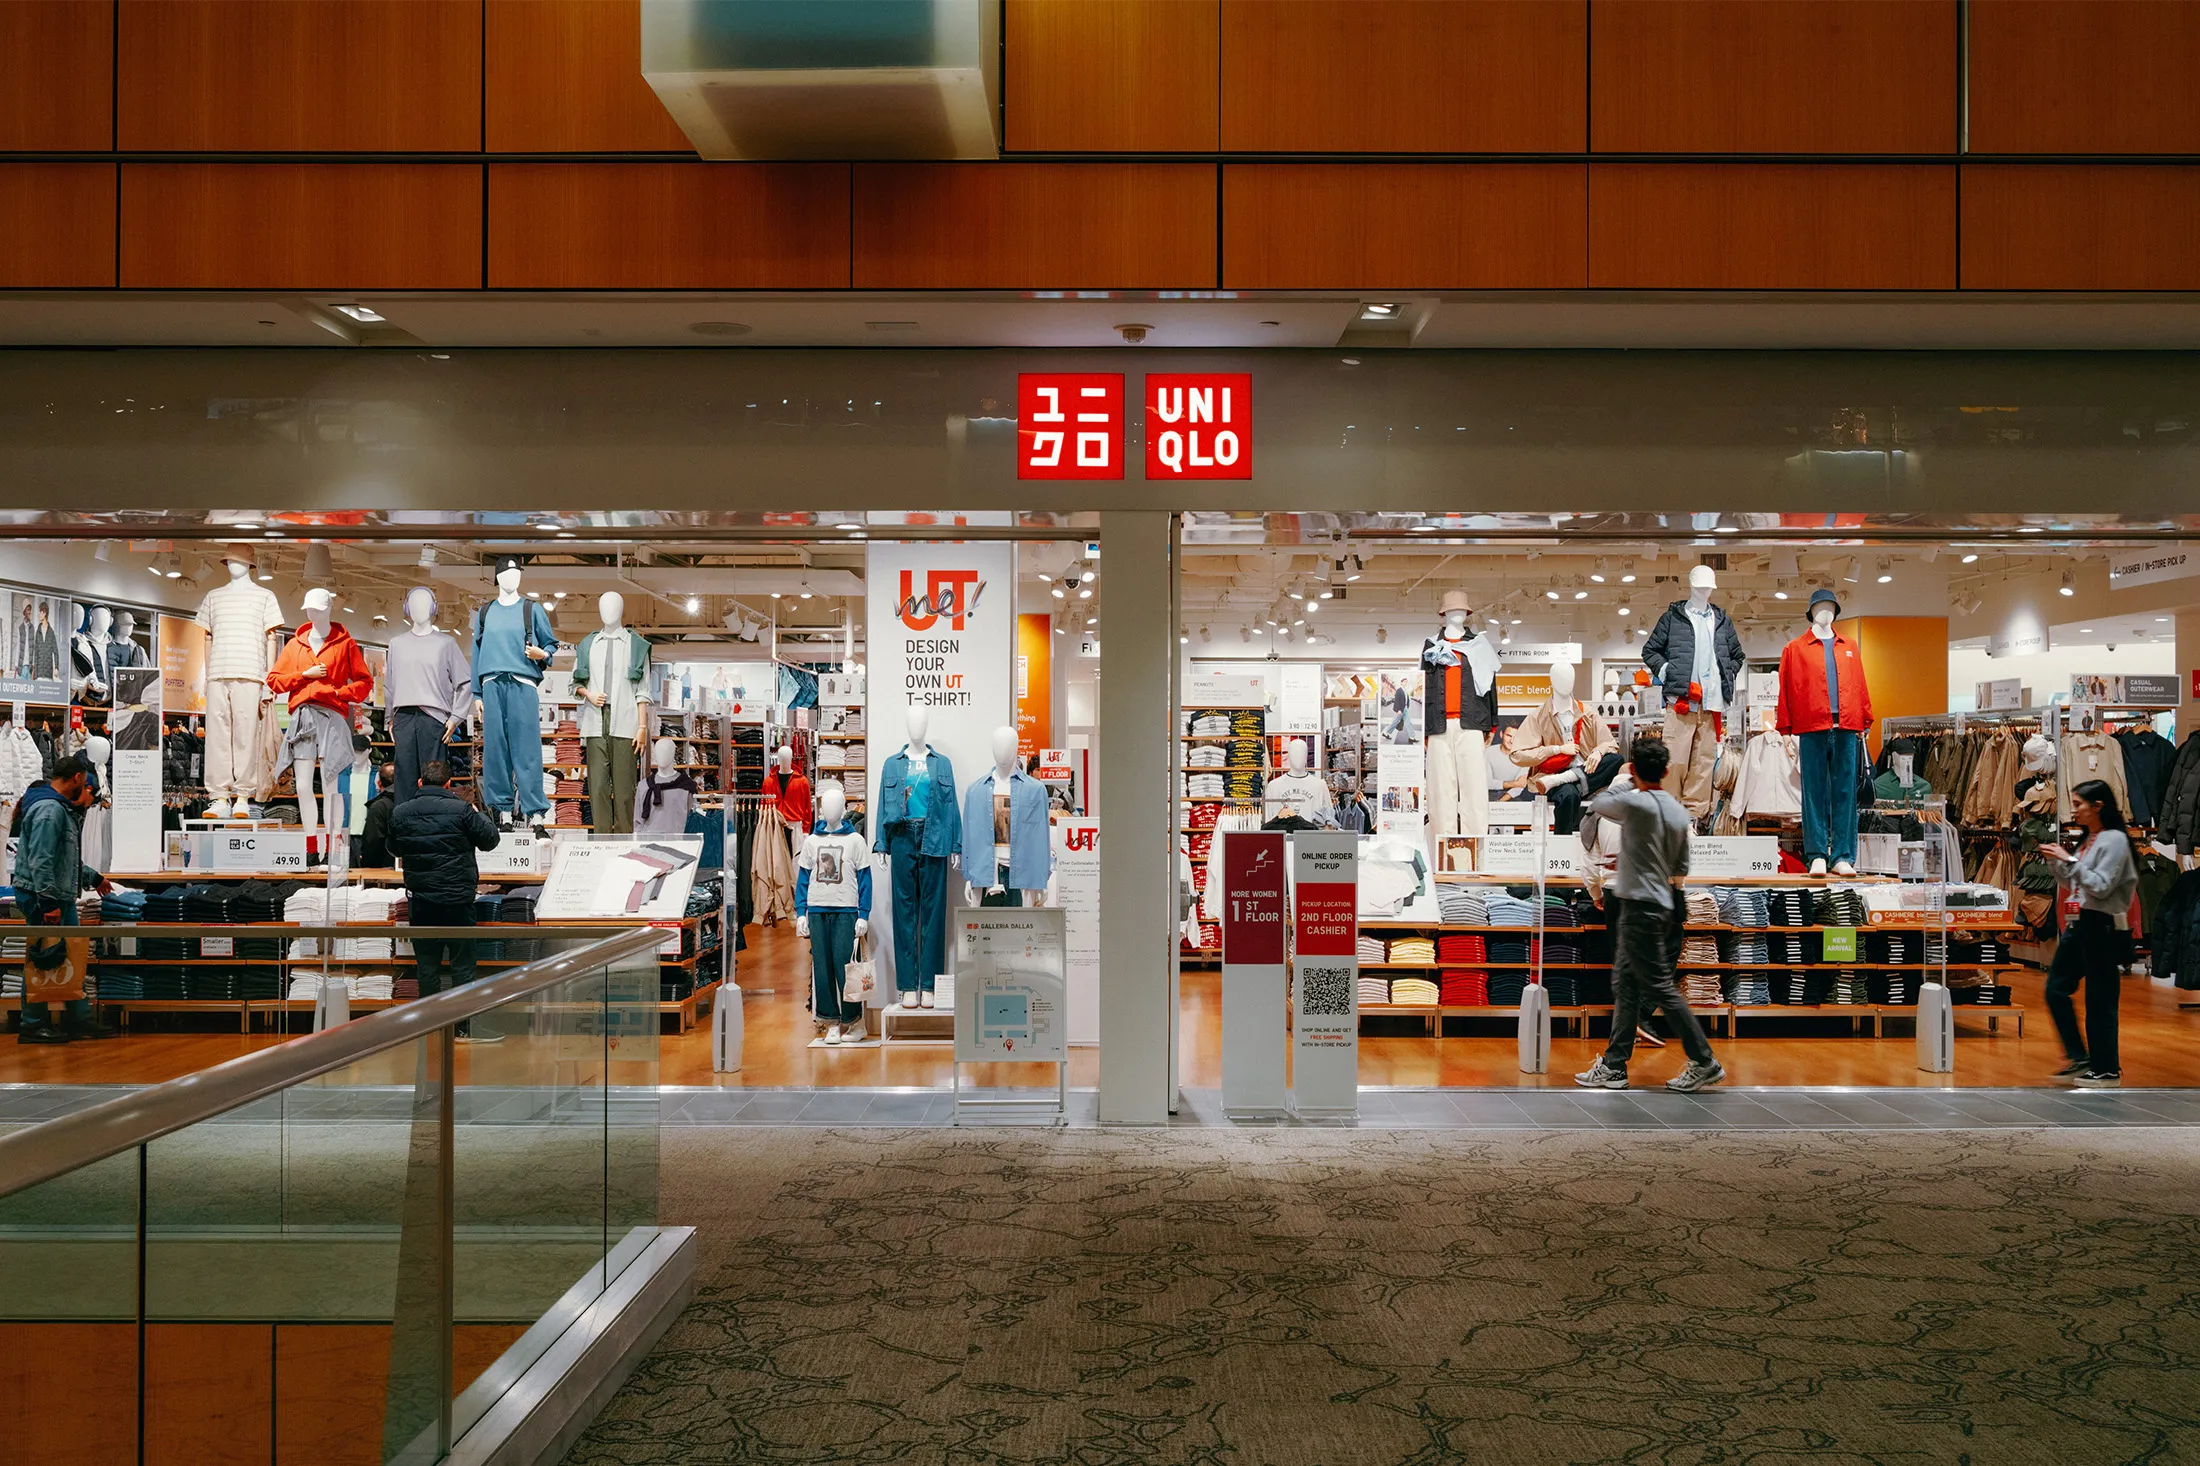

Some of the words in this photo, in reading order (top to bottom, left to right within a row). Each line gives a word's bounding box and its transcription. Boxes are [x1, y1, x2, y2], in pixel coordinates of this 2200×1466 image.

[1033, 387, 1109, 423] ユニ
[1158, 387, 1231, 423] UNI
[1158, 430, 1239, 473] QLO
[2122, 563, 2140, 575] CASHIER
[2145, 558, 2167, 572] IN-STORE
[2167, 555, 2178, 567] PICK
[2179, 554, 2187, 565] UP
[900, 569, 978, 631] UT
[906, 639, 960, 654] DESIGN
[906, 657, 945, 671] YOUR
[906, 675, 941, 689] OWN
[946, 675, 963, 689] UT
[2, 682, 35, 694] OUTERWEAR
[1497, 686, 1524, 694] MERE
[1527, 686, 1551, 694] blend
[906, 692, 971, 706] T-SHIRT!
[1018, 714, 1036, 723] thing
[1067, 828, 1098, 852] UT
[1301, 852, 1328, 860] ONLINE
[1330, 852, 1353, 860] ORDER
[1314, 862, 1340, 870] PICKUP
[1550, 860, 1570, 869] 39.90
[1231, 890, 1250, 898] MORE
[1252, 890, 1278, 898] WOMEN
[1232, 900, 1240, 922] 1
[1246, 901, 1259, 910] ST
[1246, 912, 1279, 922] FLOOR
[1301, 912, 1320, 922] 2ND
[1323, 912, 1353, 922] FLOOR
[1306, 926, 1347, 934] CASHIER
[967, 934, 977, 942] 2F
[1826, 944, 1852, 952] ARRIVAL
